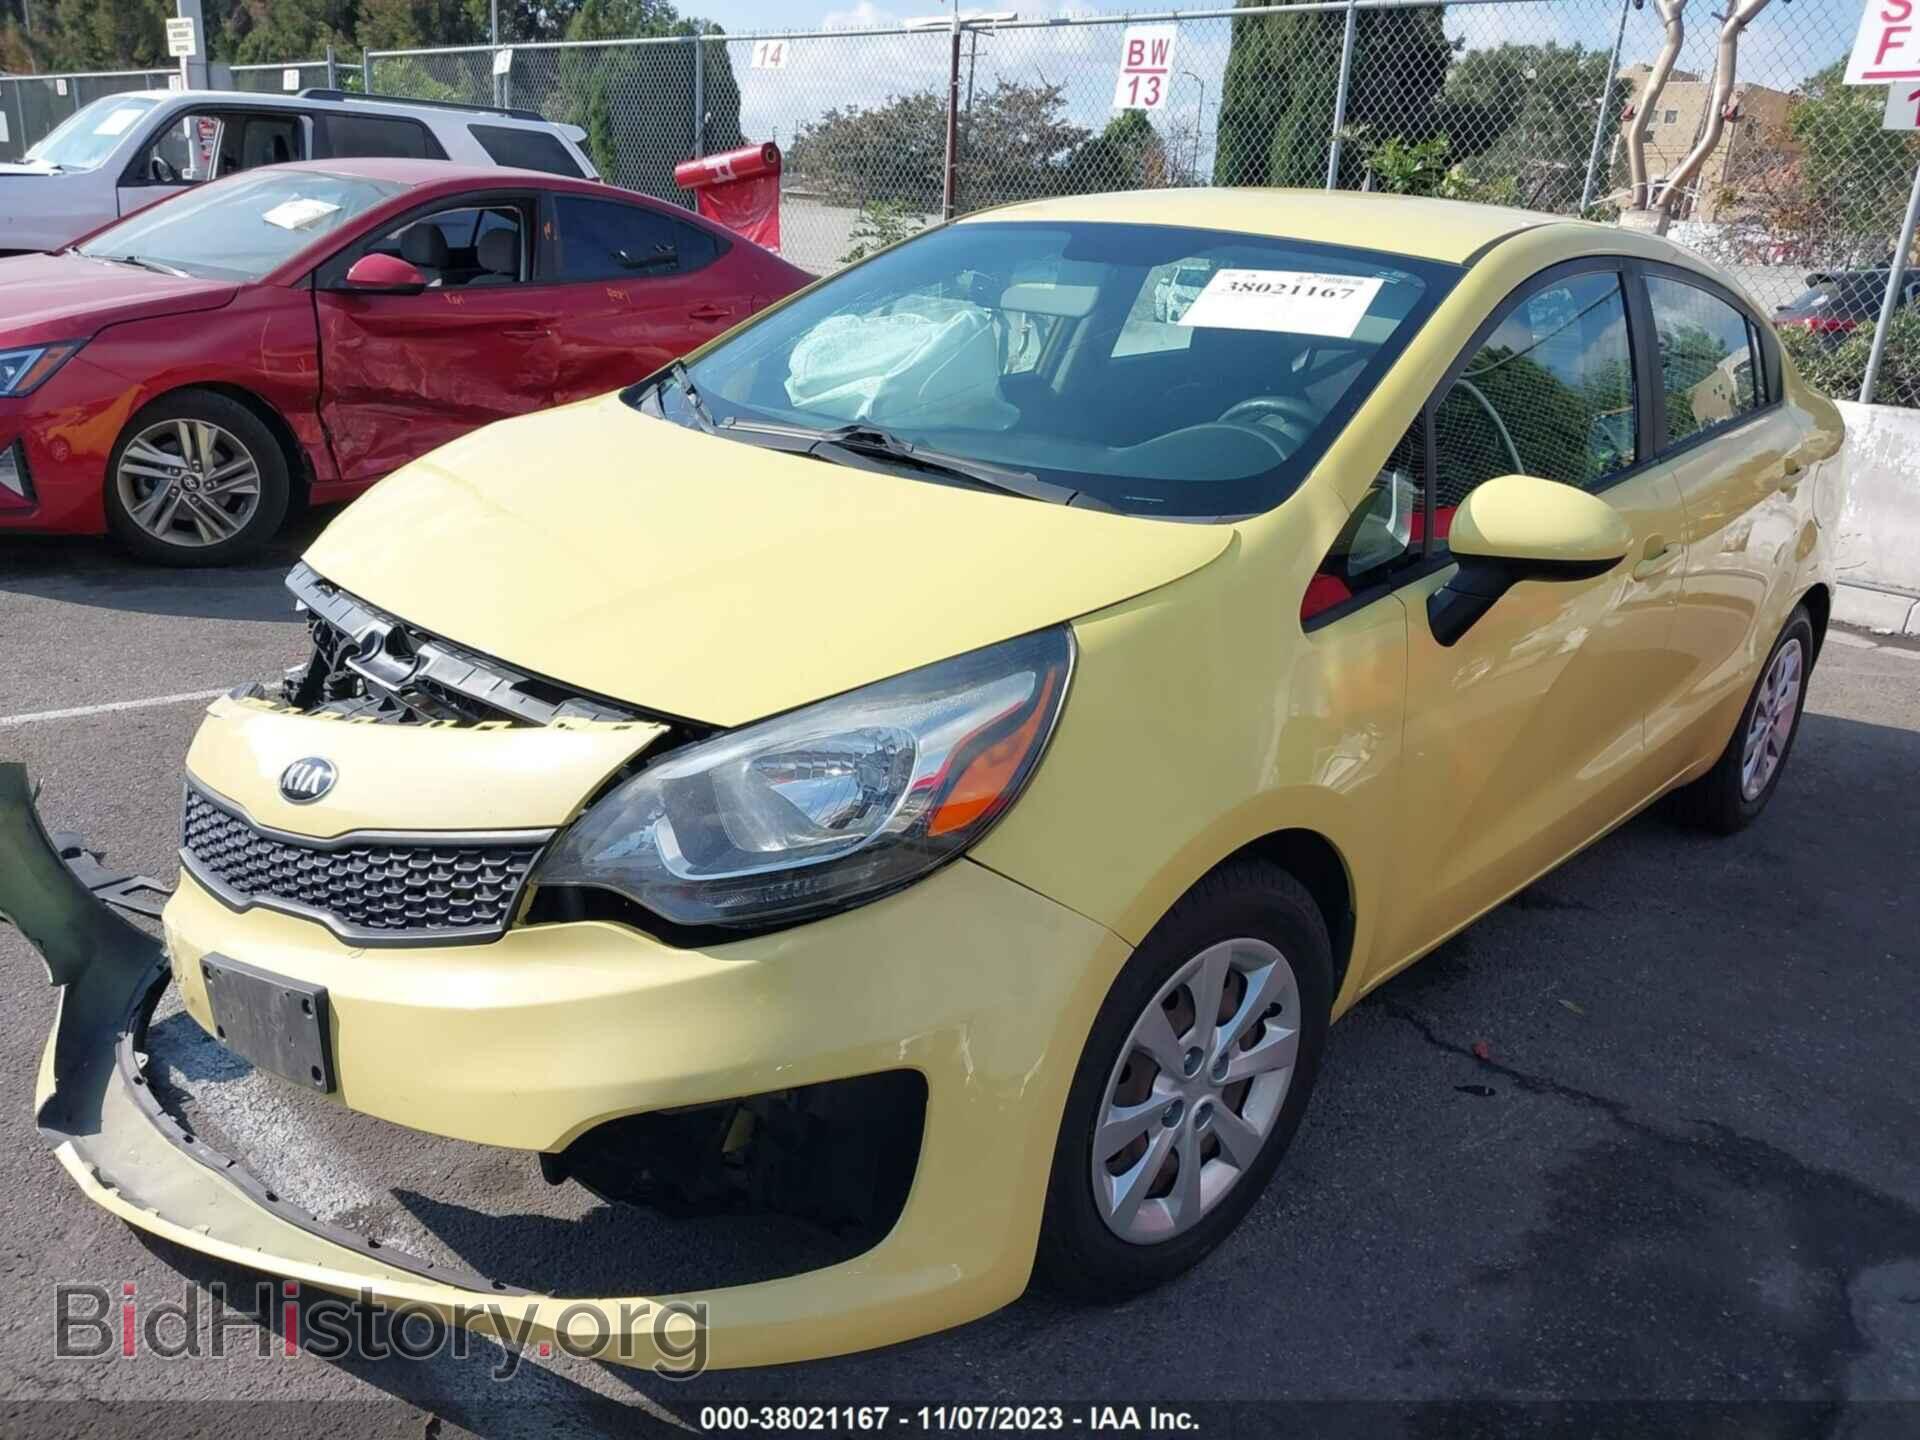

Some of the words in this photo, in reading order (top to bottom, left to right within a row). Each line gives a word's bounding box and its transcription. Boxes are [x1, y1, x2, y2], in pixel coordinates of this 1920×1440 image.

[760, 43, 783, 67] 14
[1127, 38, 1170, 66] BW
[1128, 75, 1161, 106] 13
[1221, 281, 1355, 299] 38021167
